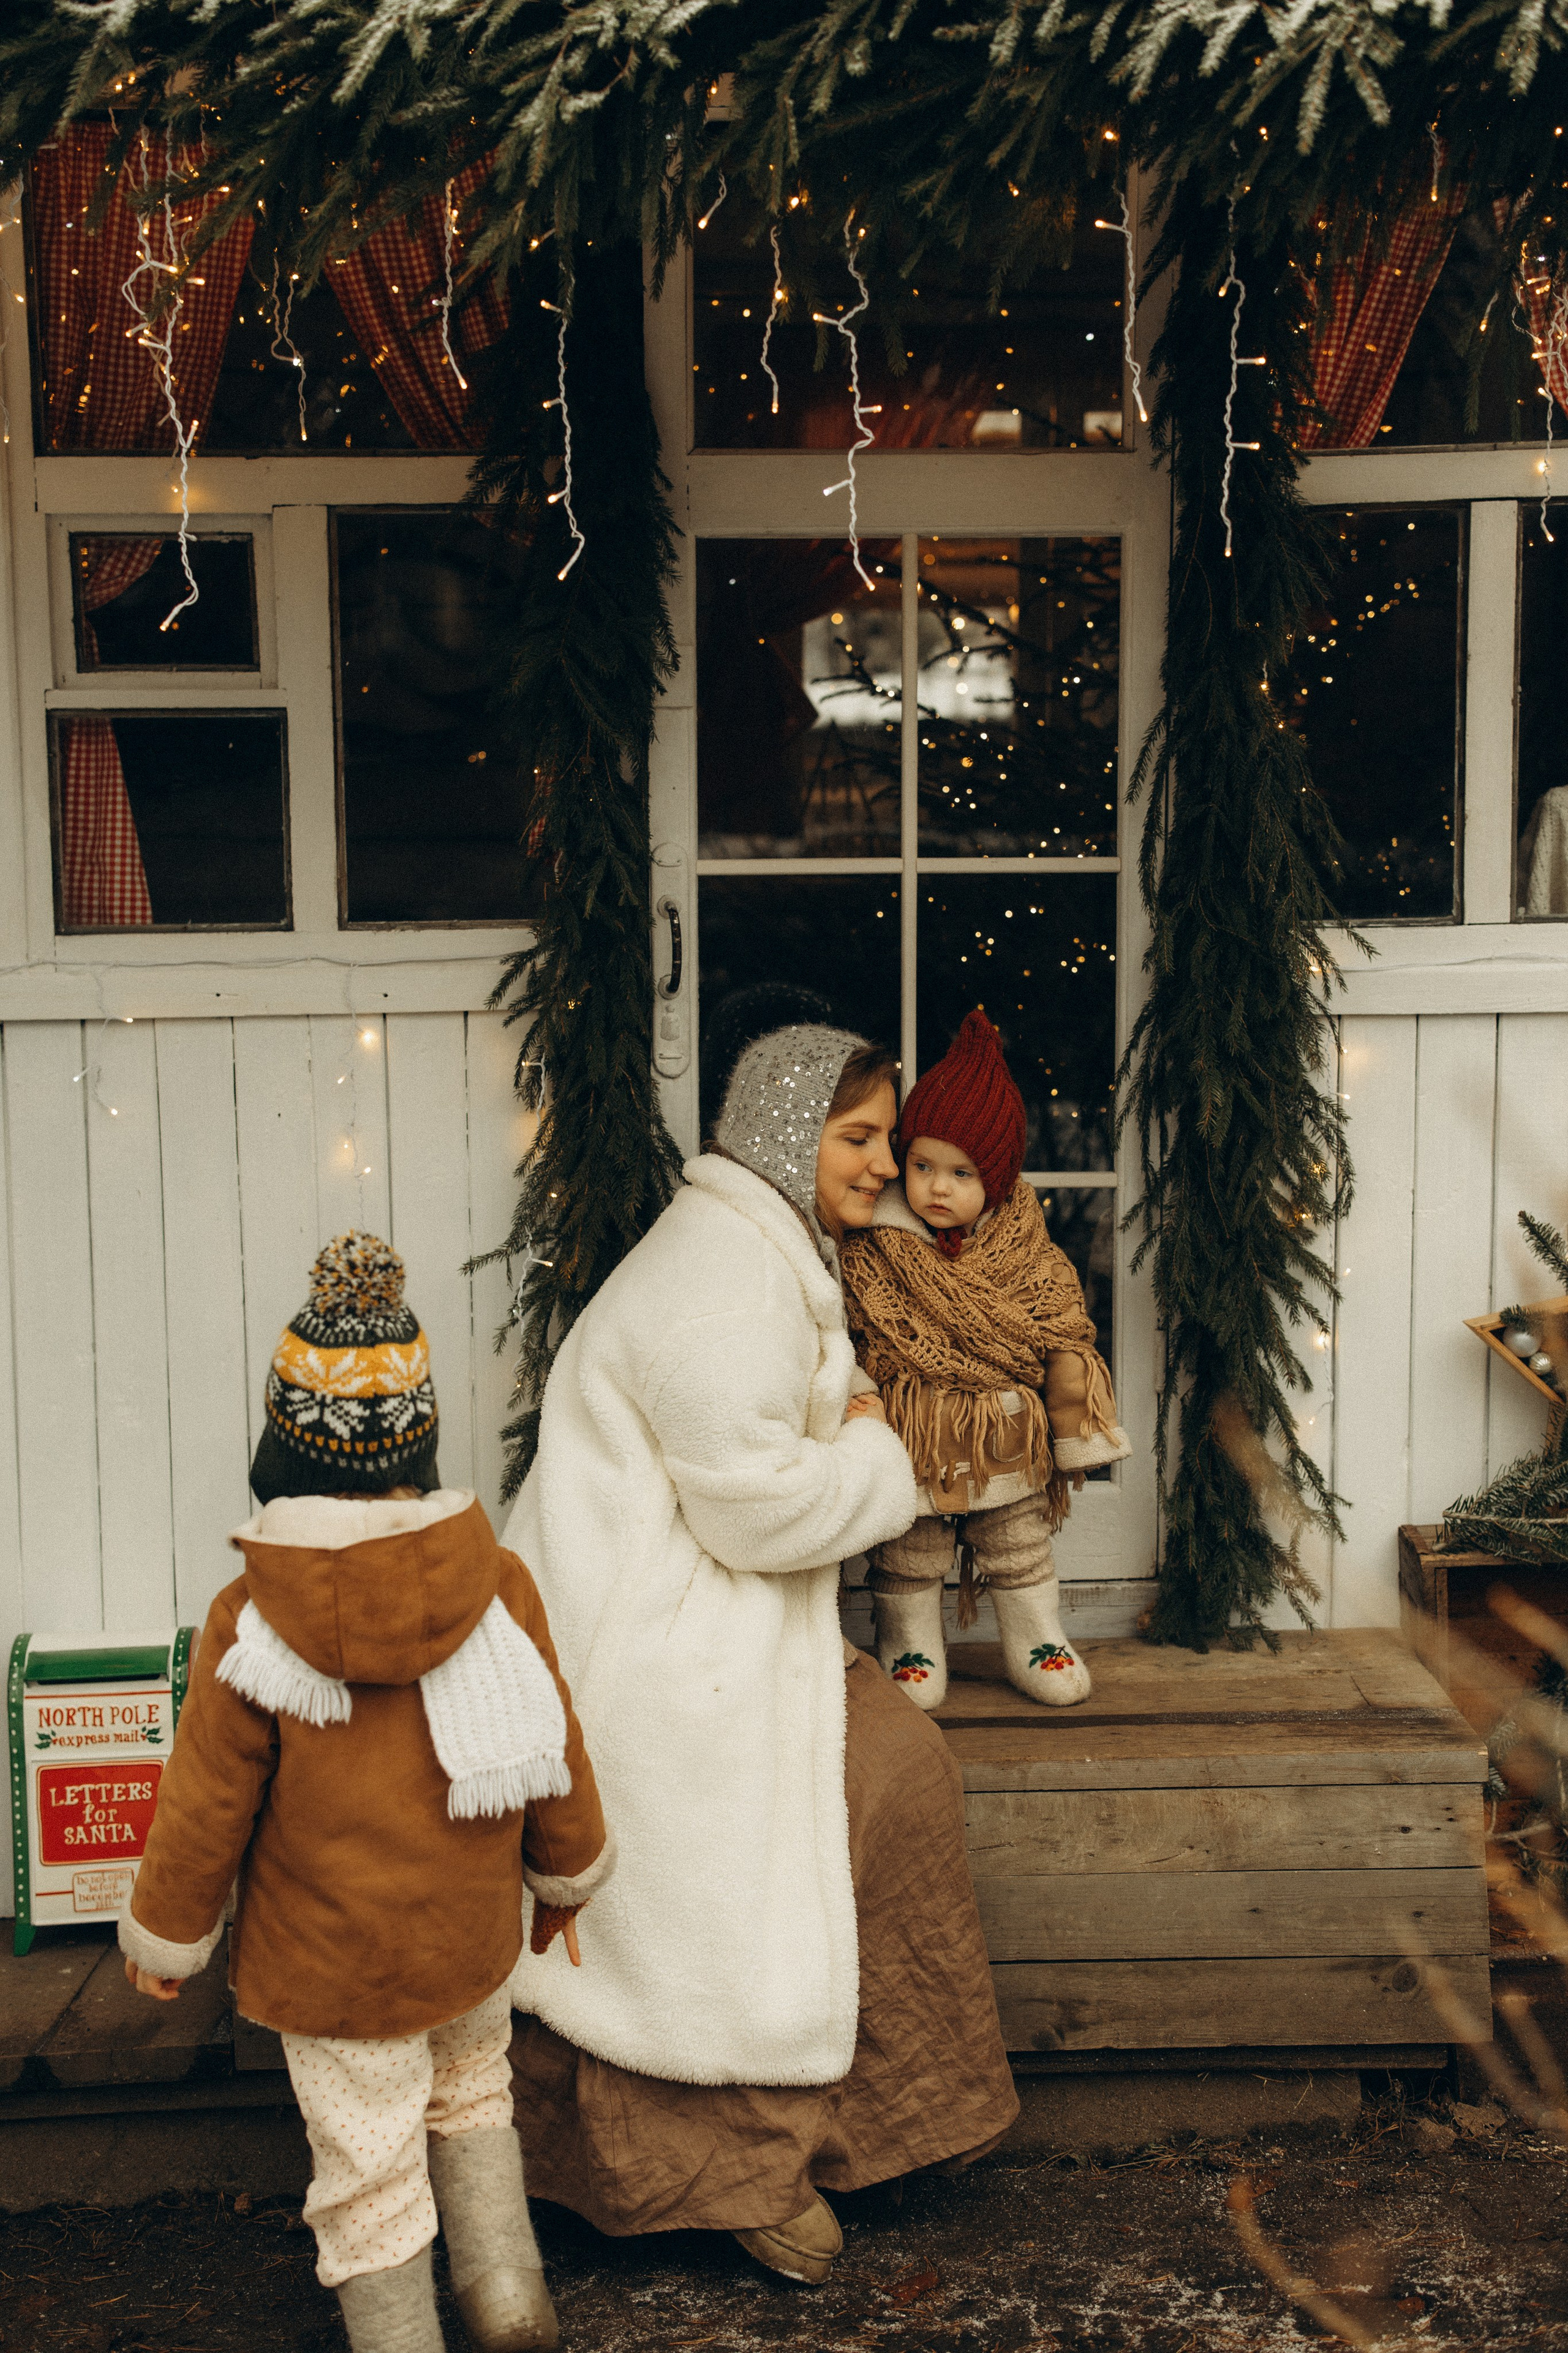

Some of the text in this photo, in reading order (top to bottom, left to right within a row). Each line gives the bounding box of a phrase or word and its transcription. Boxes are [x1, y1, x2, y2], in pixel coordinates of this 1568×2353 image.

[39, 1704, 159, 1728] NORTH POLE
[58, 1729, 138, 1747] express mail
[49, 1781, 153, 1807] LETTERS
[83, 1803, 118, 1824] for
[64, 1823, 137, 1845] SANTA
